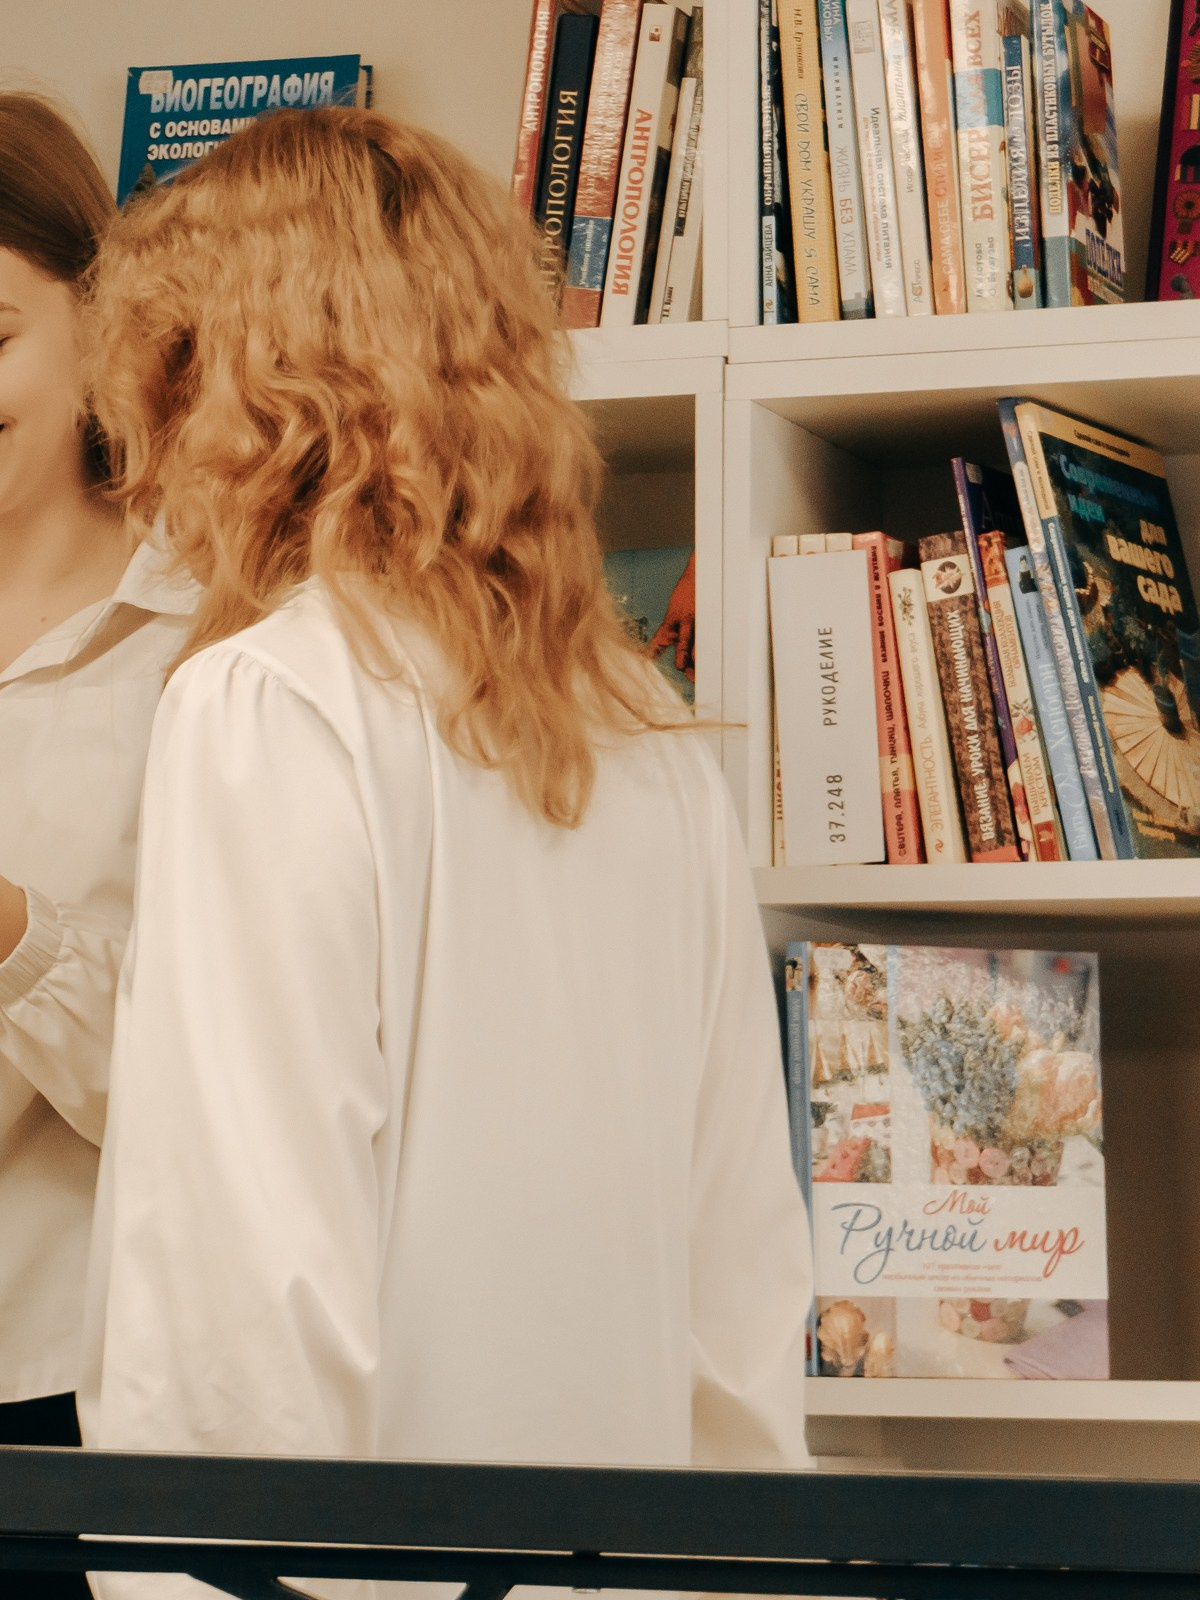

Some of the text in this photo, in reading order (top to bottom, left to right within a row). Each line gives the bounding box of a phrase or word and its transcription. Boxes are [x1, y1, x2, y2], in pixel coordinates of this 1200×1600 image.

[965, 9, 982, 66] ВСЕХ
[525, 10, 551, 131] АНТРОПОЛОГИЯ
[149, 122, 161, 139] С
[871, 107, 884, 169] Идеальная
[1041, 2, 1061, 213] ПОДЕЛКИ ИЗ ПЛАСТИКОВЫХ БУТЫЛОК
[968, 128, 993, 221] БИСЕР
[1007, 64, 1031, 241] ИЗДЕЛИЯ ЛОЗЫ
[612, 108, 652, 296] АНТРОПОЛОГИЯ
[799, 140, 820, 305] ДОМ УКРАШУ Я САМА
[836, 145, 857, 275] ЖИЗНЬ БЕЗ ХЛАМА
[877, 173, 888, 218] система
[937, 199, 950, 234] СЕБЕ
[764, 223, 773, 286] АННА ЗАЙЦЕВА
[882, 222, 893, 268] питания
[1106, 534, 1174, 579] вашего
[1139, 518, 1167, 546] для
[1137, 574, 1183, 616] сада
[995, 600, 1015, 687] БОЛЬШАЯ КОЛЛЕКЦИЯ
[1006, 614, 1020, 669] ОРНАМЕНТОВ
[817, 626, 845, 844] РУКОДЕЛИЕ 37.248
[949, 608, 994, 841] ВЯЗАНИЕ. УРОКИ ДЛЯ НАЧИНАЮЩИХ
[1024, 751, 1039, 815] ВЫШИВАЕМ
[1033, 755, 1047, 808] КРЕСТОМ
[923, 1189, 991, 1217] Мой
[831, 1203, 1085, 1284] Ручной мир
